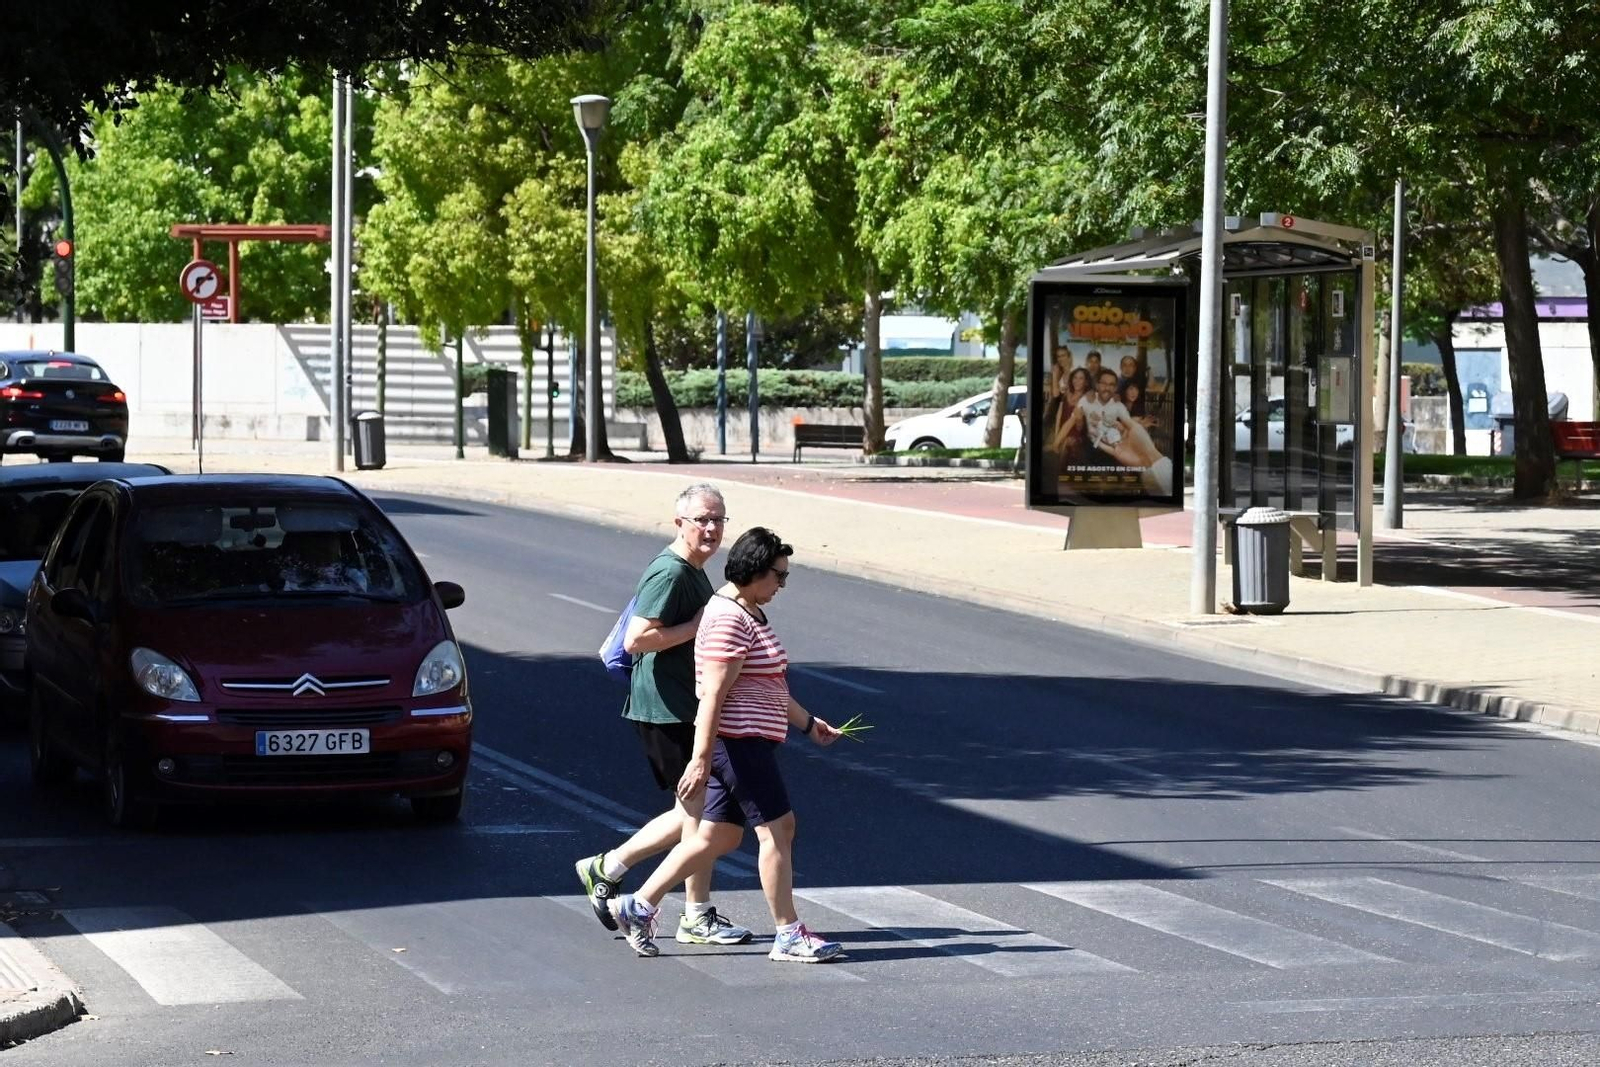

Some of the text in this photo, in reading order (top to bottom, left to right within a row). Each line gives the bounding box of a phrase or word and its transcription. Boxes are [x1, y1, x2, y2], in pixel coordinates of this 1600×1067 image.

[1284, 217, 1291, 227] 2
[268, 732, 363, 752] 6327 GFB
